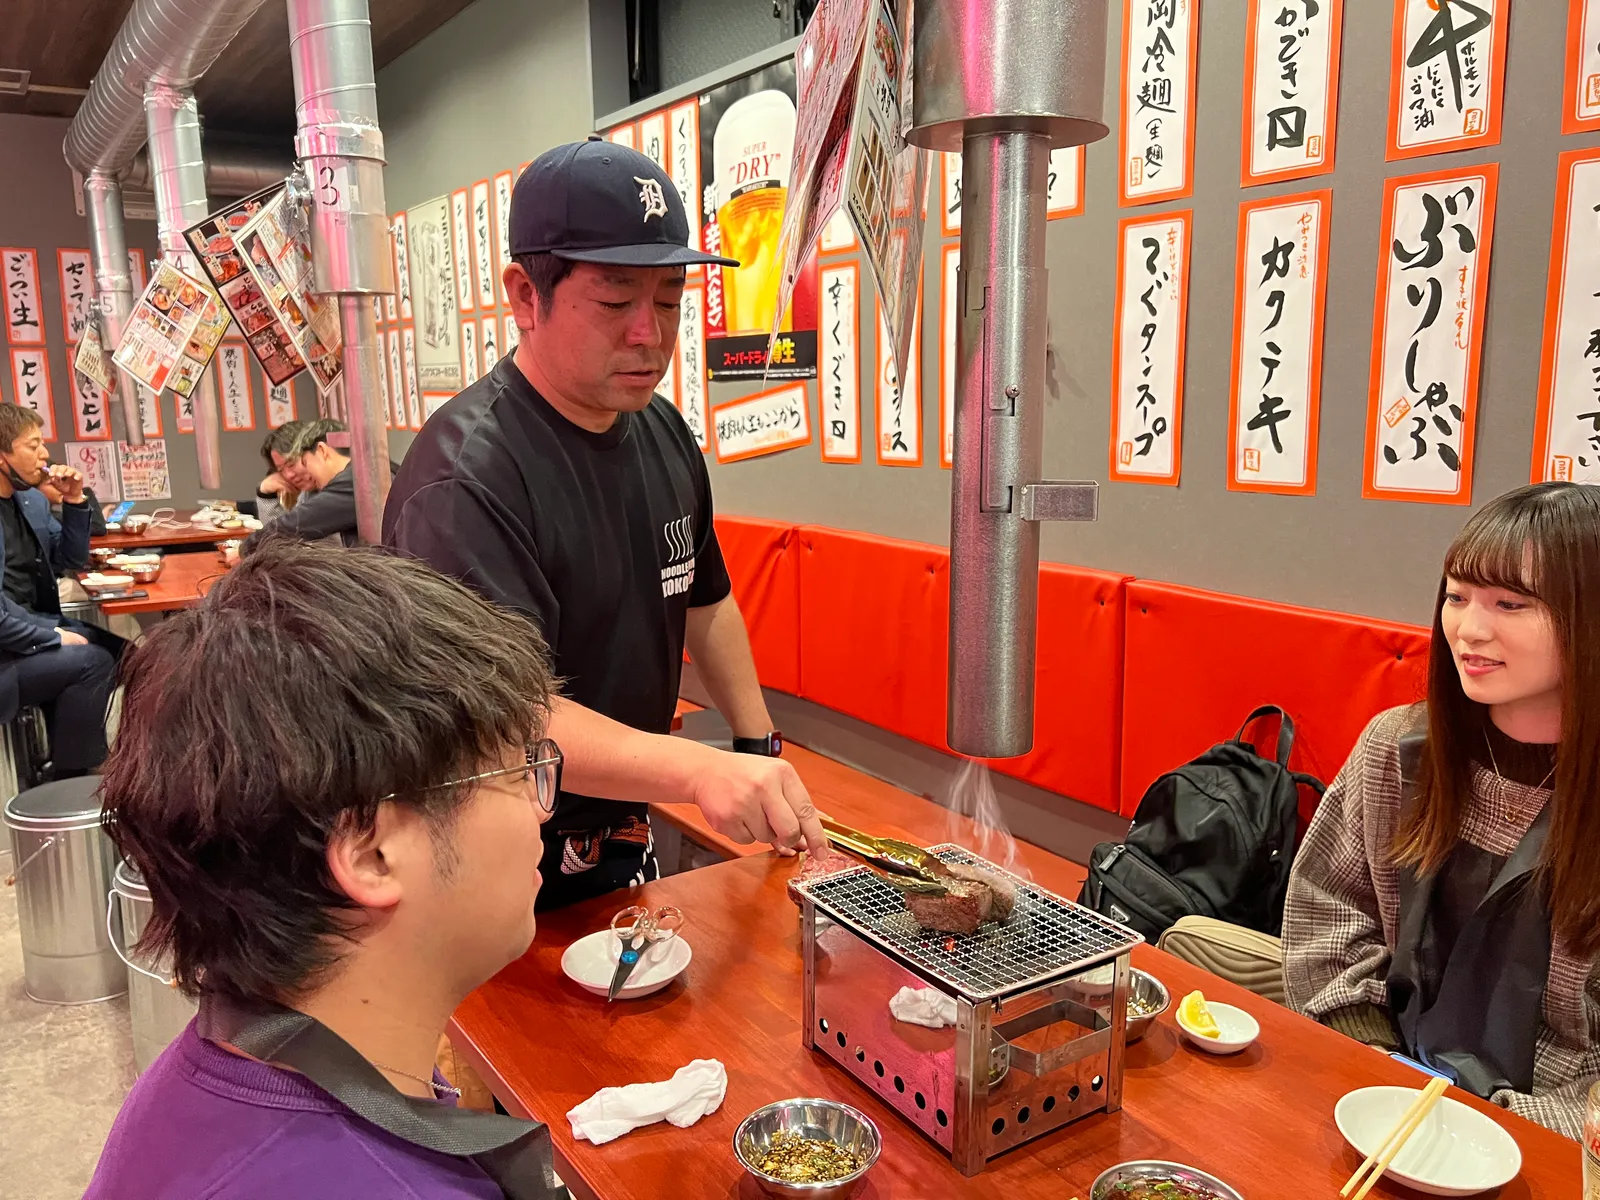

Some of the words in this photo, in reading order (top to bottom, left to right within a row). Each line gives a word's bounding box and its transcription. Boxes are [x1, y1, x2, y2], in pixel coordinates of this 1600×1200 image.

[742, 141, 767, 157] SUPER
[319, 166, 340, 207] 3
[633, 176, 669, 223] D
[103, 296, 113, 315] 5
[1246, 236, 1295, 454] カクテキ
[1384, 186, 1477, 471] ぶりしゃぶ
